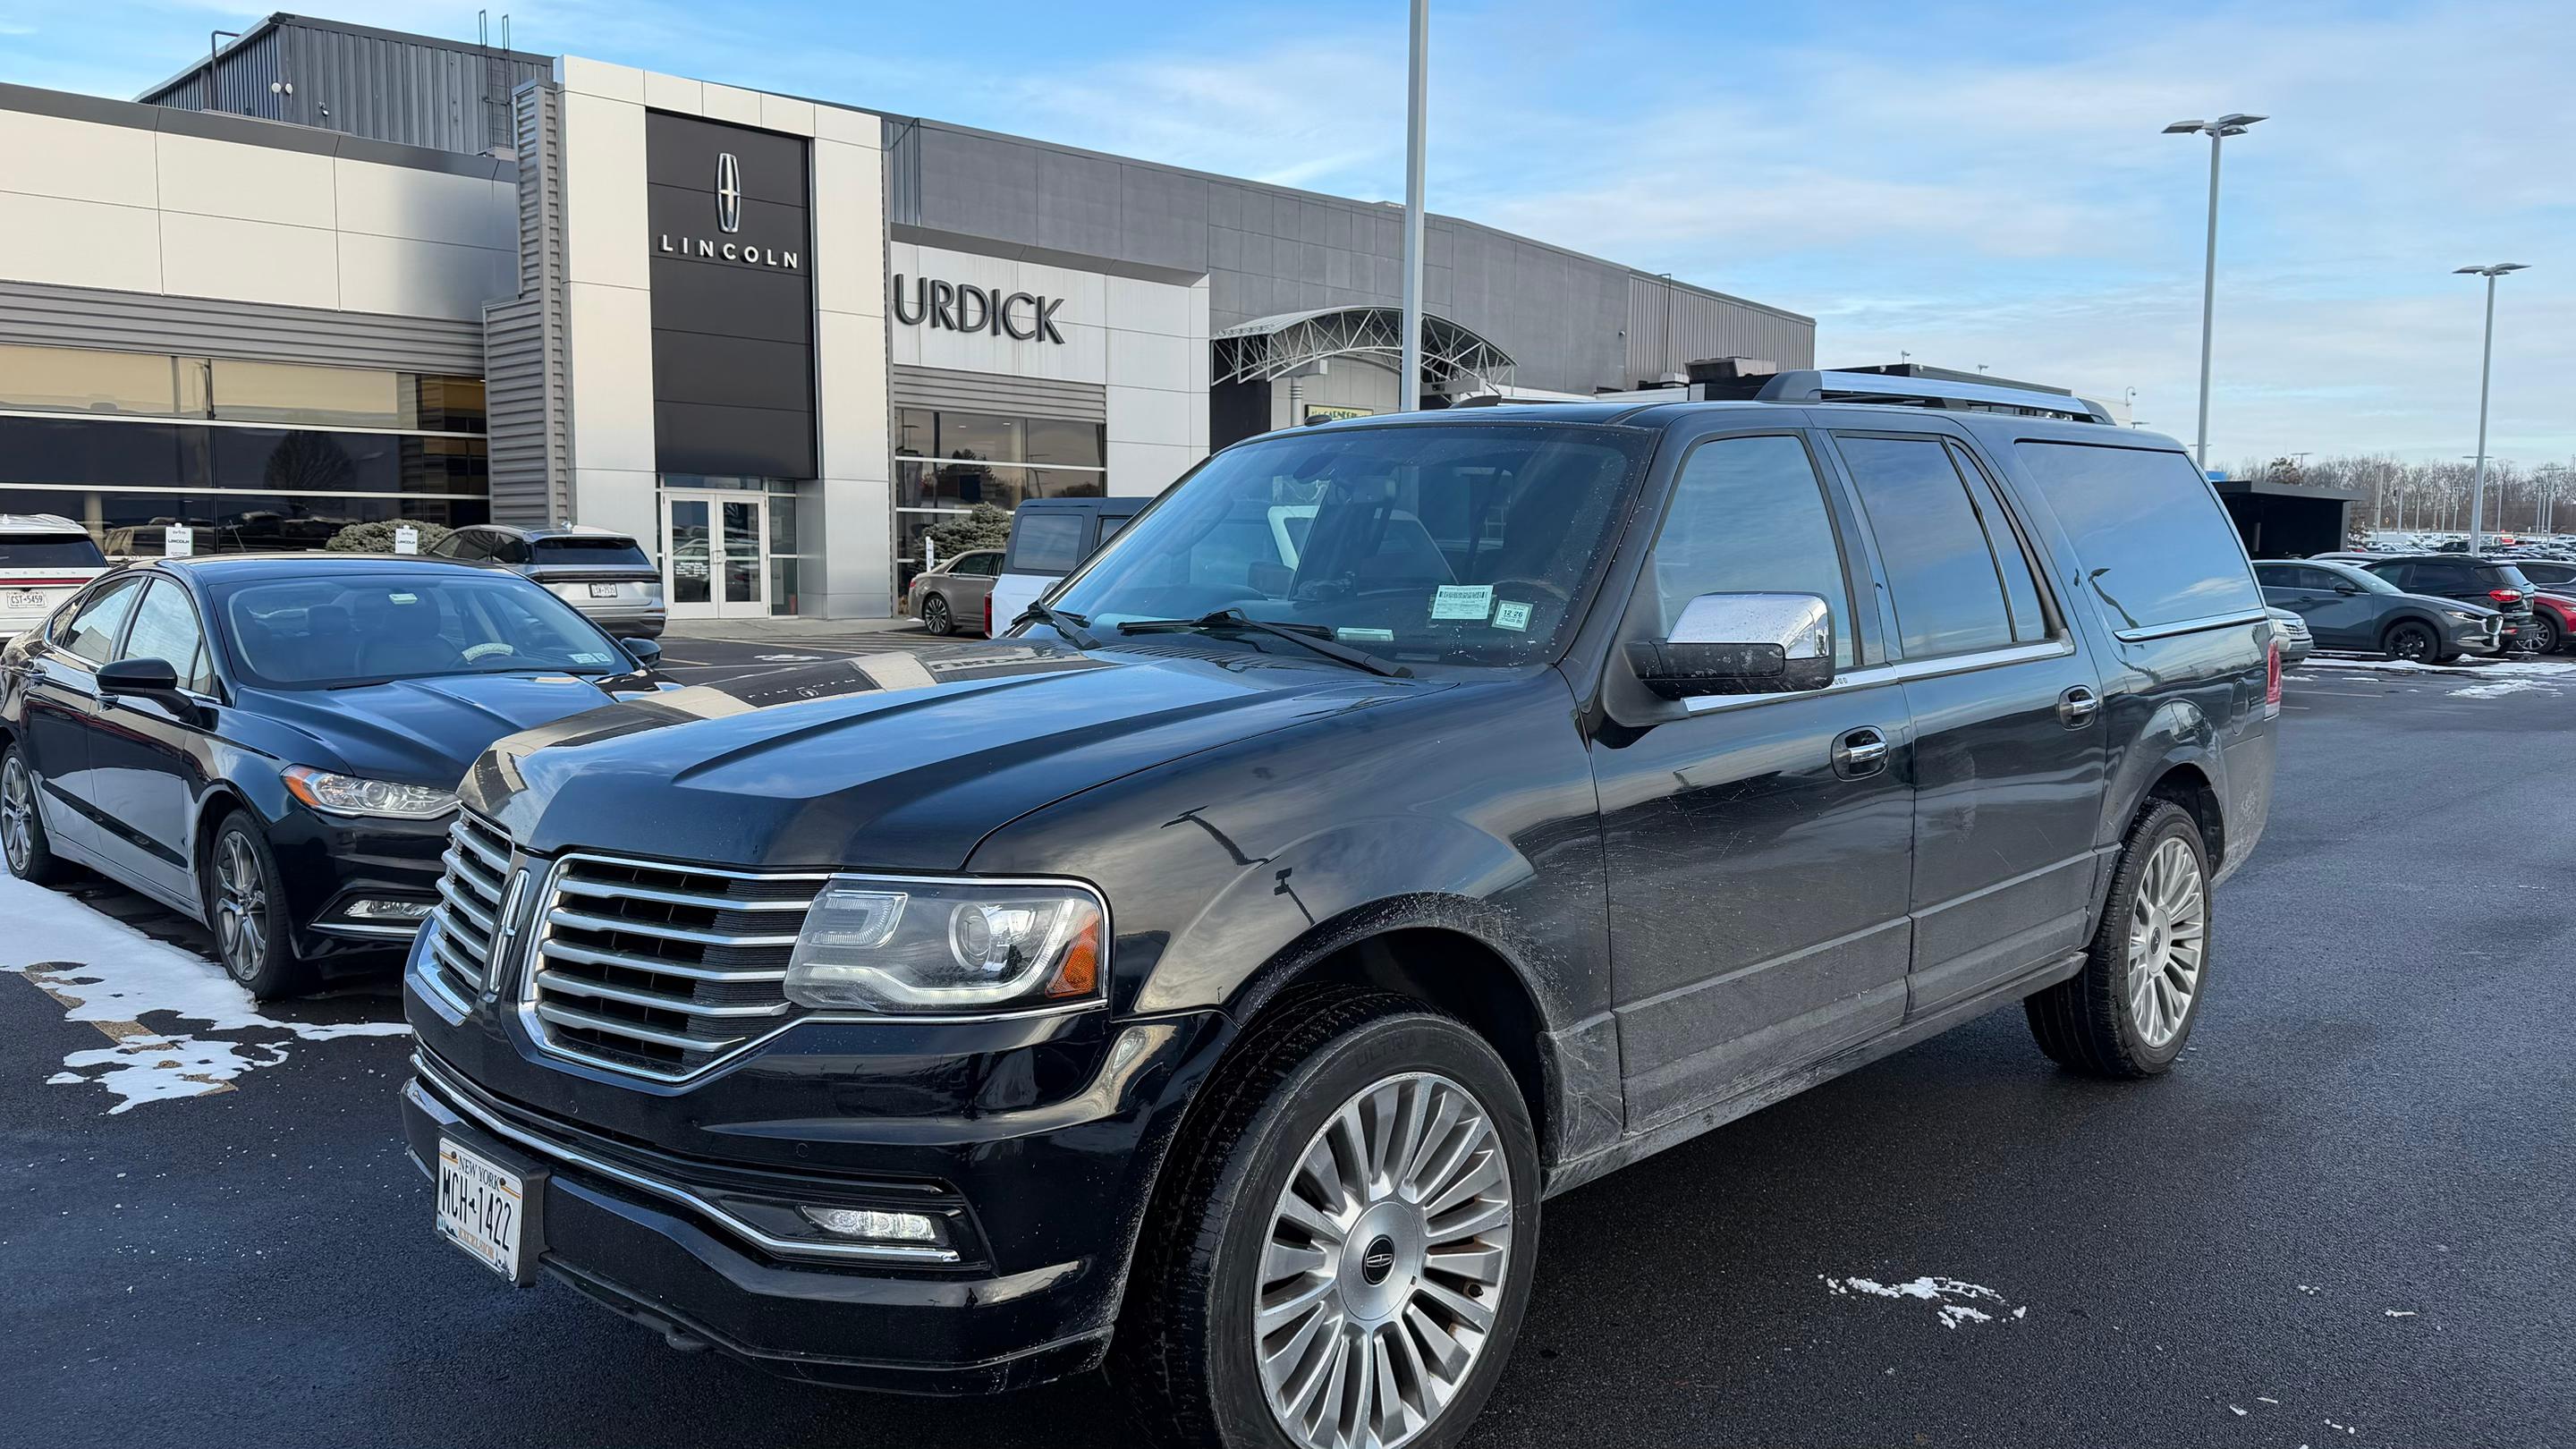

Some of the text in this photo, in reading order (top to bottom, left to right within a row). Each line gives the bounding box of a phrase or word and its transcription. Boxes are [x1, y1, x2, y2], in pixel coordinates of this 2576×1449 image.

[660, 233, 798, 269] LINCOLN
[894, 273, 1065, 344] URDICK
[1353, 1030, 1419, 1068] ULTRA
[458, 1155, 500, 1192] NEW YORK
[442, 1165, 513, 1252] MCH 1422
[458, 1226, 495, 1260] EXCELSIOR
